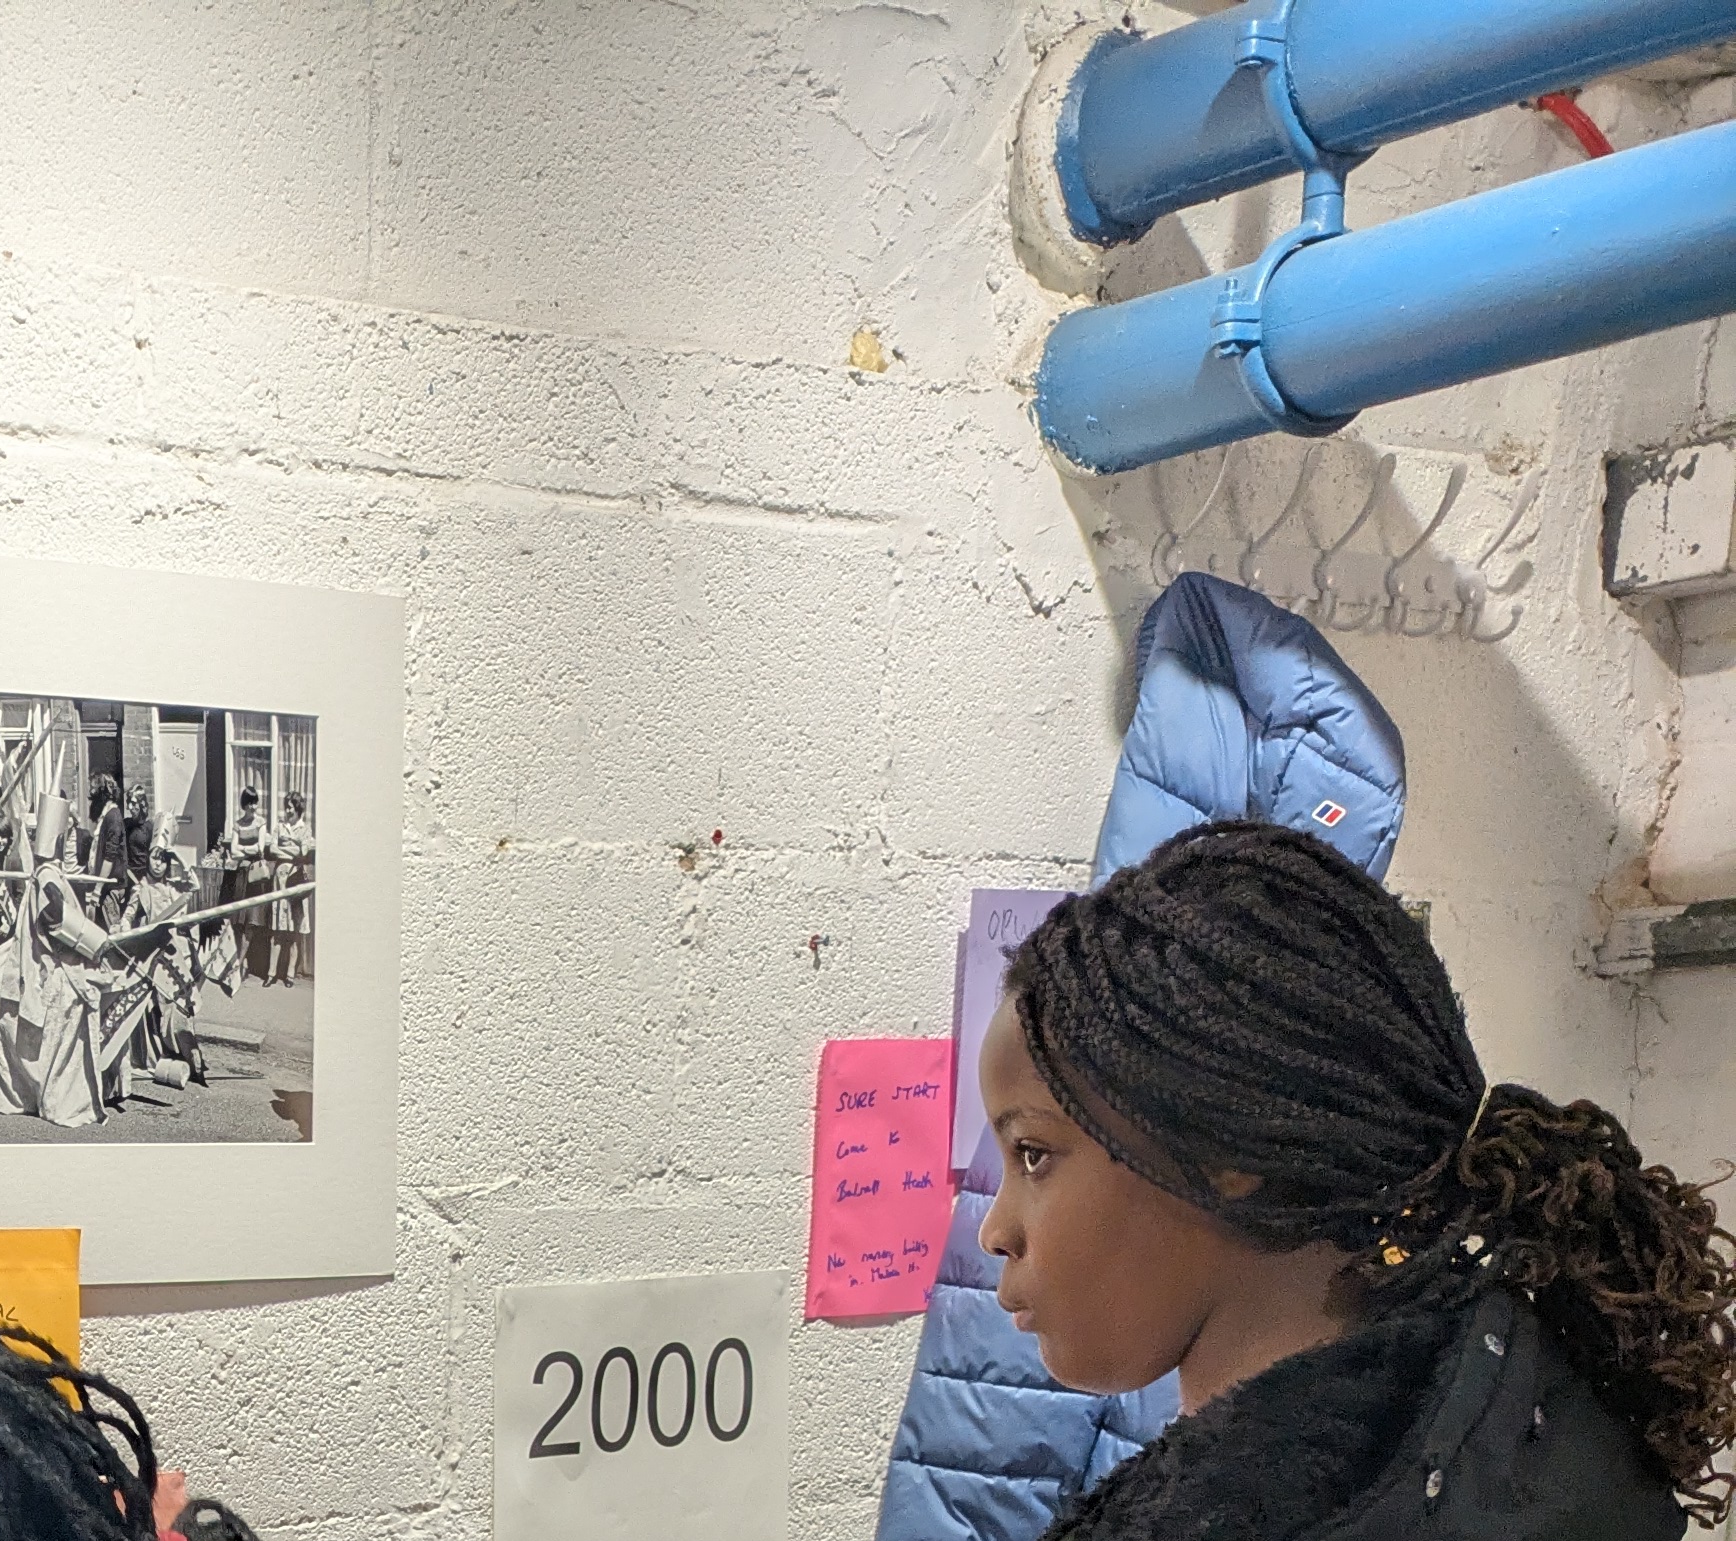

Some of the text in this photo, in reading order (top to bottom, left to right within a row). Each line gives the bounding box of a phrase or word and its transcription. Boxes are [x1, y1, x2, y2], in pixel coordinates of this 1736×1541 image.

[835, 1085, 940, 1112] SURE START
[837, 1131, 900, 1159] Come to
[902, 1172, 933, 1192] Heath
[529, 1338, 753, 1459] 2000
